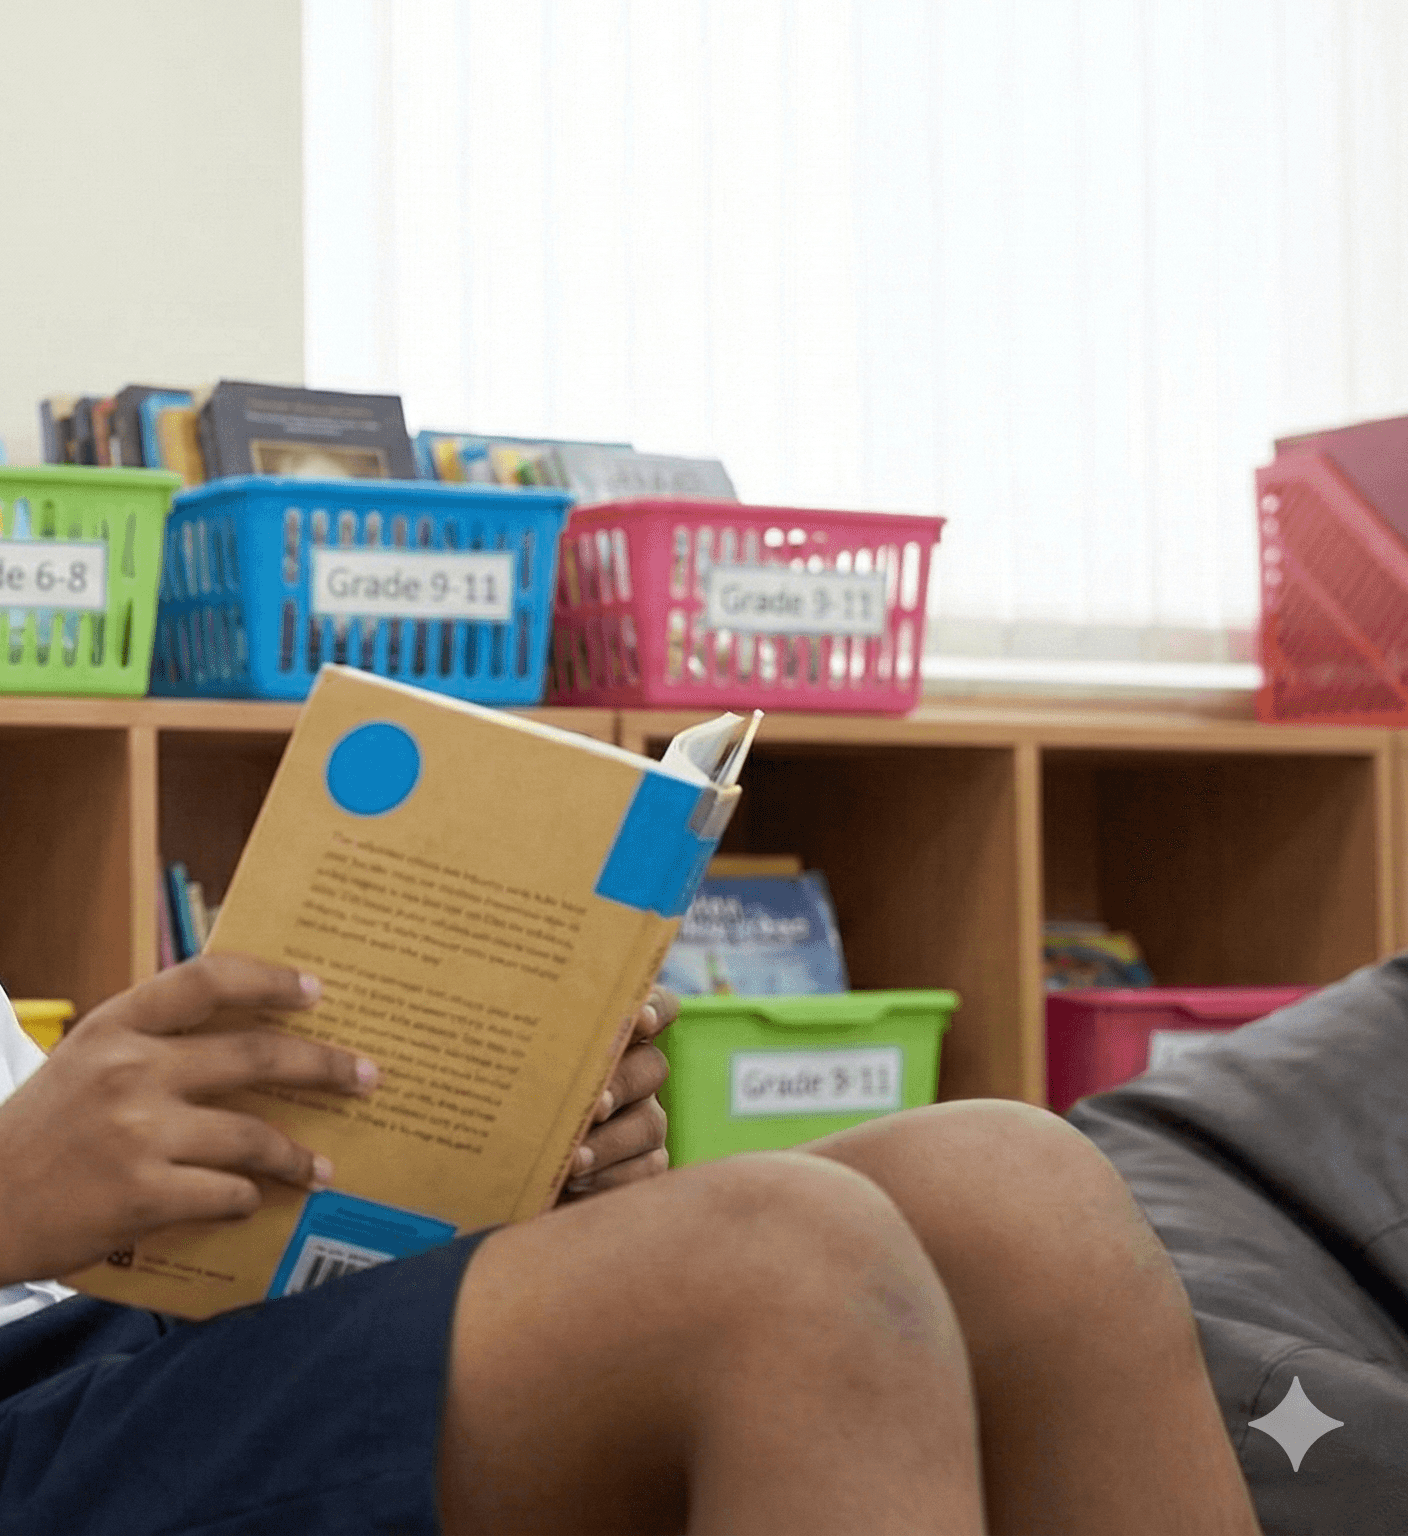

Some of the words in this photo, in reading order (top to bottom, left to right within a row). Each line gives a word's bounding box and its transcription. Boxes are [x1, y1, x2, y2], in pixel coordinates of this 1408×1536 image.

[35, 560, 88, 593] 6-8
[327, 565, 421, 602] Grade
[430, 570, 498, 605] 9-11
[720, 582, 801, 616] Grade
